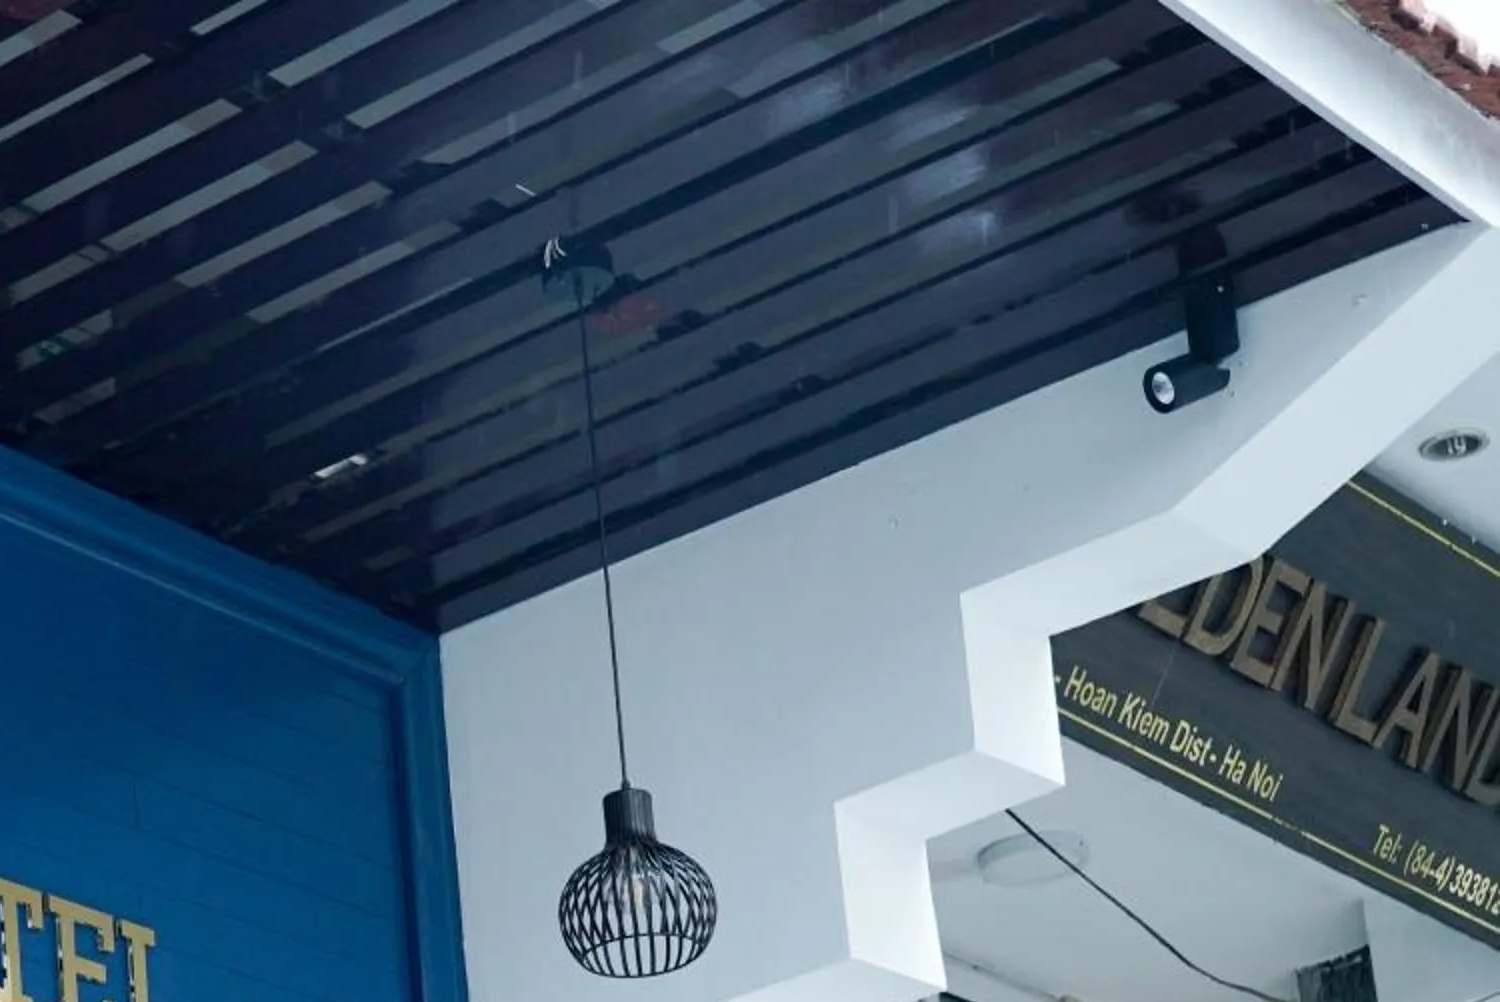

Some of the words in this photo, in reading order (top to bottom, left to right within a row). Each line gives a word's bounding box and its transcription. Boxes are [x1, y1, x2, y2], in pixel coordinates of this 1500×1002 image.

[1063, 665, 1118, 719] Hoan
[1118, 691, 1171, 736] Kiem
[1218, 743, 1246, 785] Ha
[1246, 758, 1284, 803] Noi
